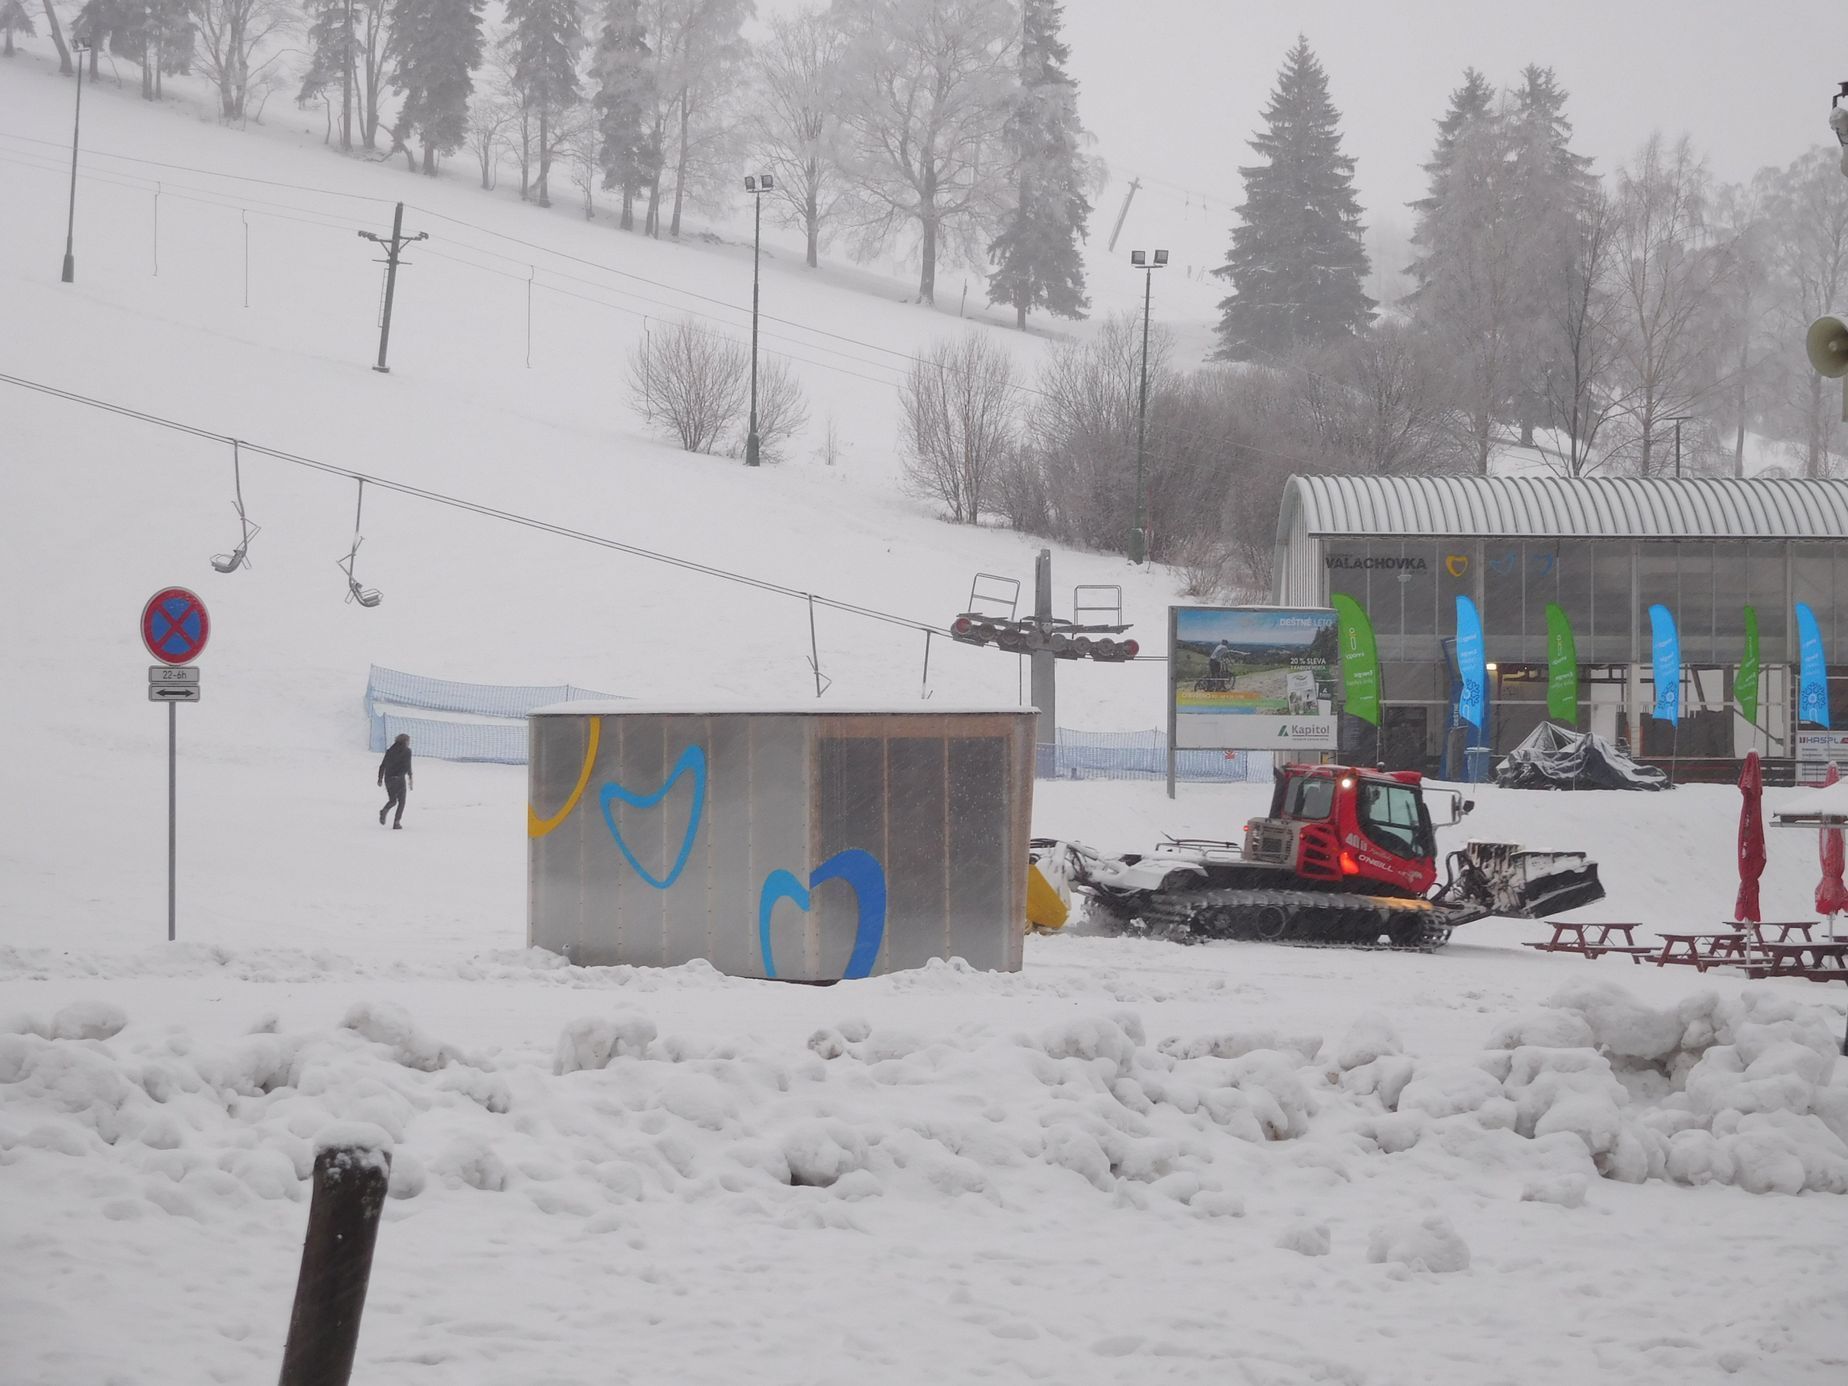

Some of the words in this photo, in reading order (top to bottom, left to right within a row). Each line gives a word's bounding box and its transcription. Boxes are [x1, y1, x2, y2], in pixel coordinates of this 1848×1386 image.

[1326, 558, 1427, 569] VALACHOVKA
[1290, 657, 1298, 665] 20
[1306, 657, 1326, 665] SLEVA
[163, 671, 186, 679] 22-6h
[1291, 724, 1330, 735] Kapitol
